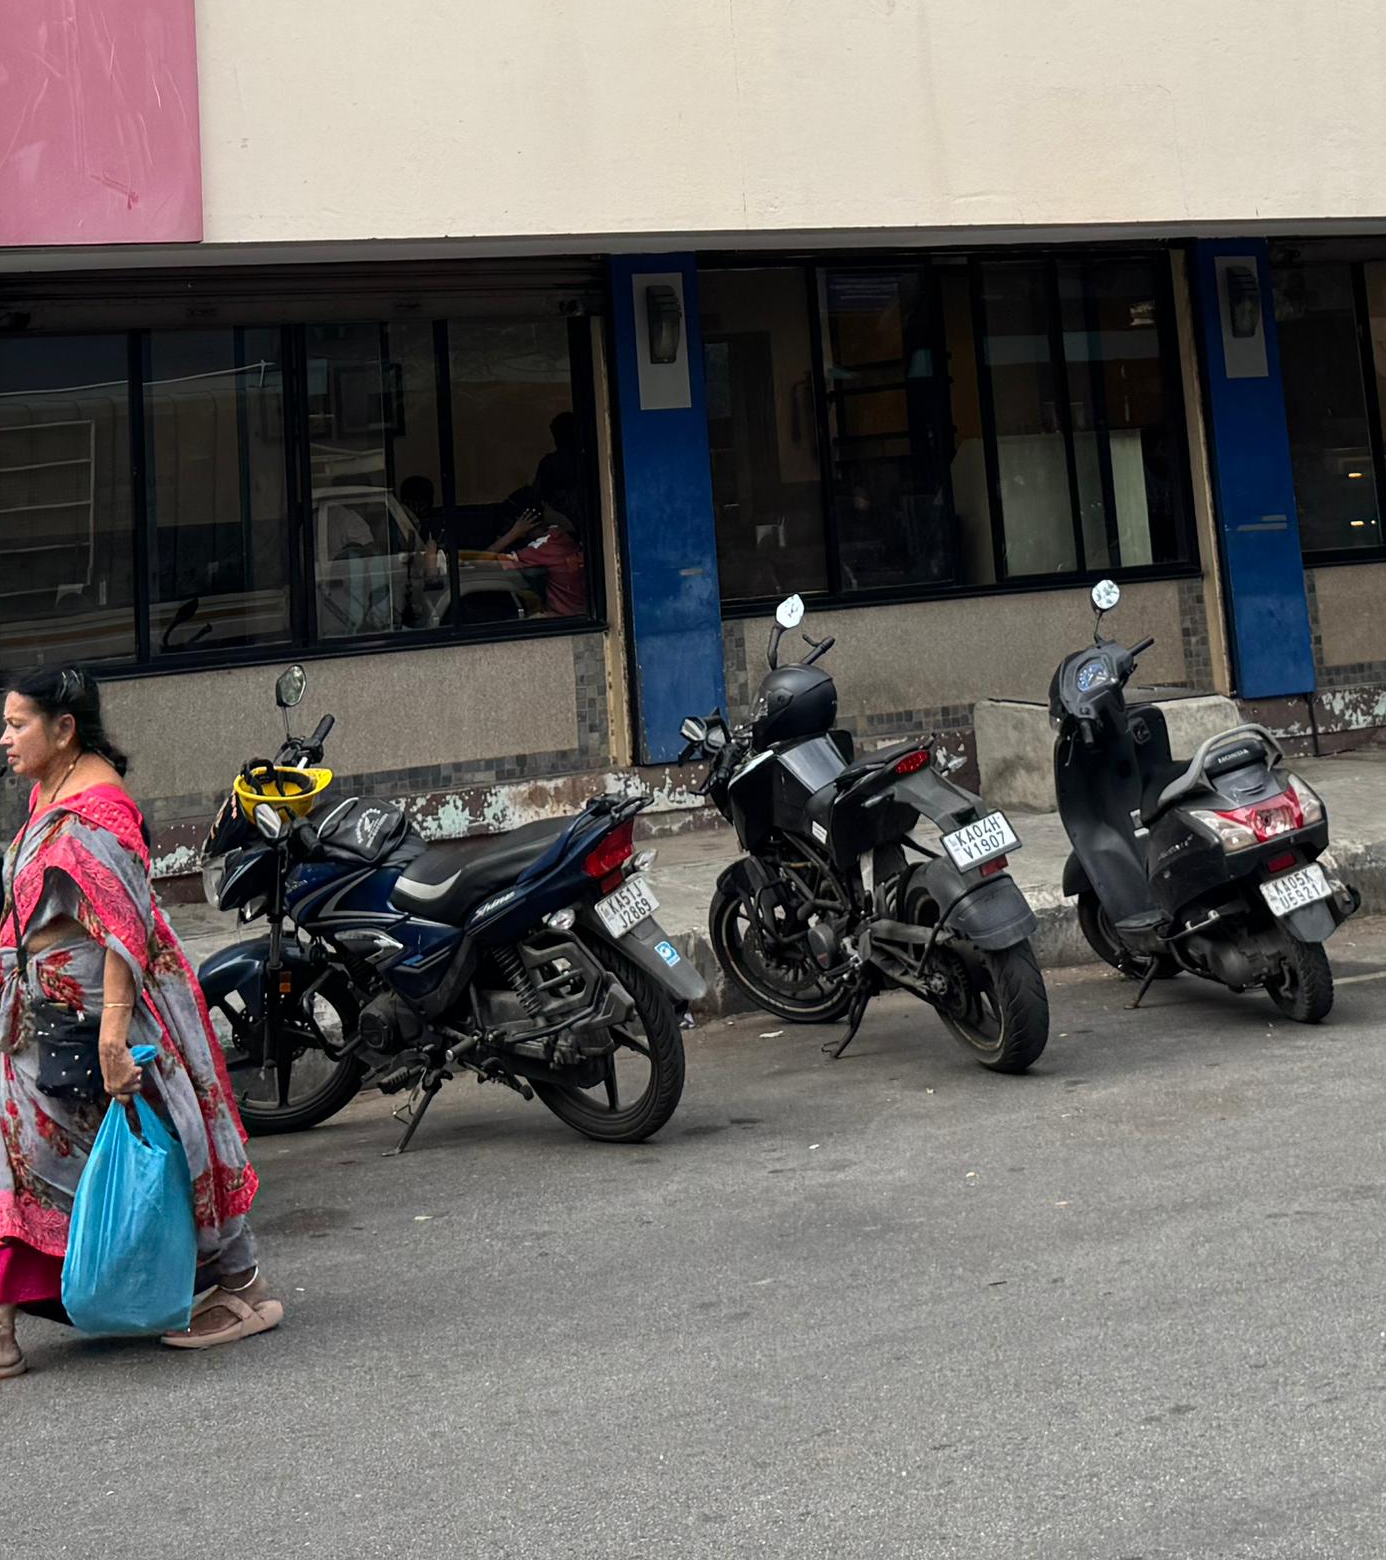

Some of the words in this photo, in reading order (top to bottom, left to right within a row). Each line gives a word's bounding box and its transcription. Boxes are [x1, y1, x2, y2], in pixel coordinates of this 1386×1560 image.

[954, 815, 1002, 848] KA04H
[963, 830, 1006, 860] V1907
[606, 881, 646, 916] KA51J
[621, 897, 653, 929] J2869
